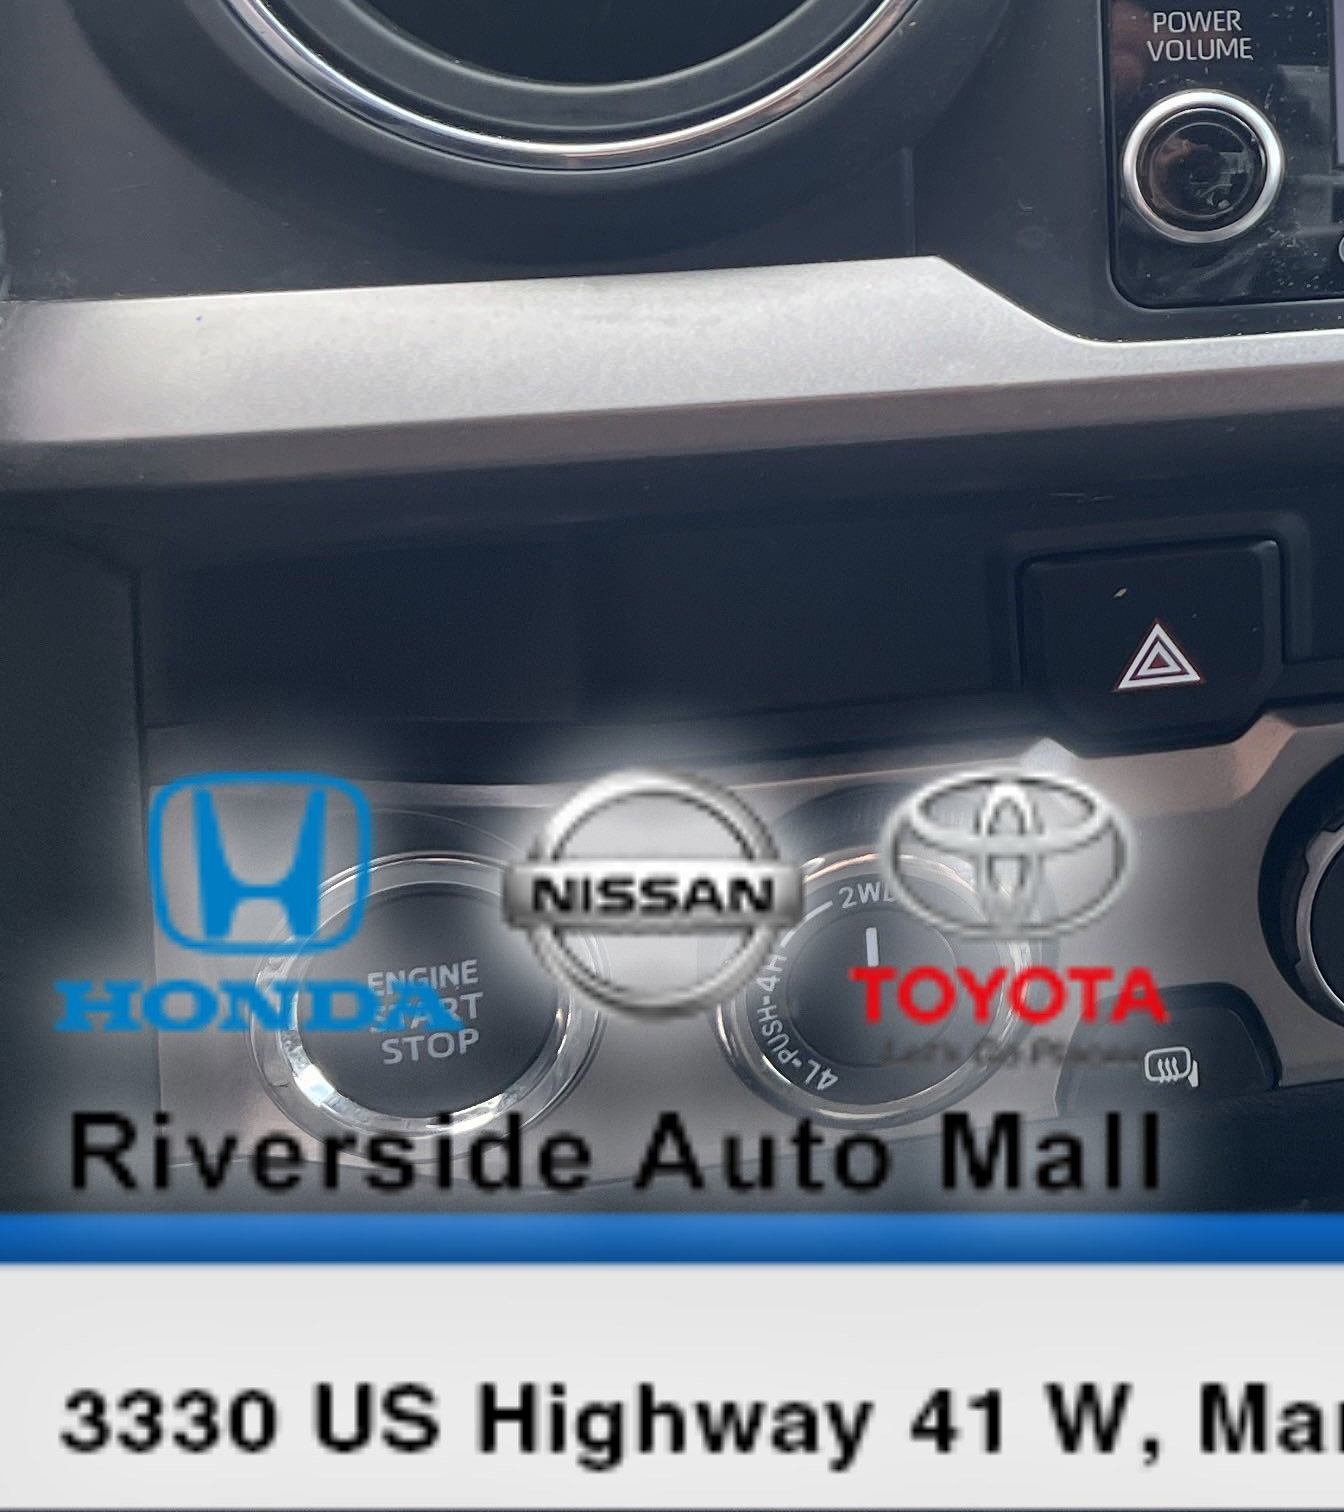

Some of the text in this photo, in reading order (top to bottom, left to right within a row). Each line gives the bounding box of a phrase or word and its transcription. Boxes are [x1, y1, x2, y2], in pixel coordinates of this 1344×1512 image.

[1152, 10, 1243, 35] POWER
[1147, 36, 1254, 63] VOLUME
[367, 958, 480, 996] ENGINE
[380, 1028, 480, 1065] STOP
